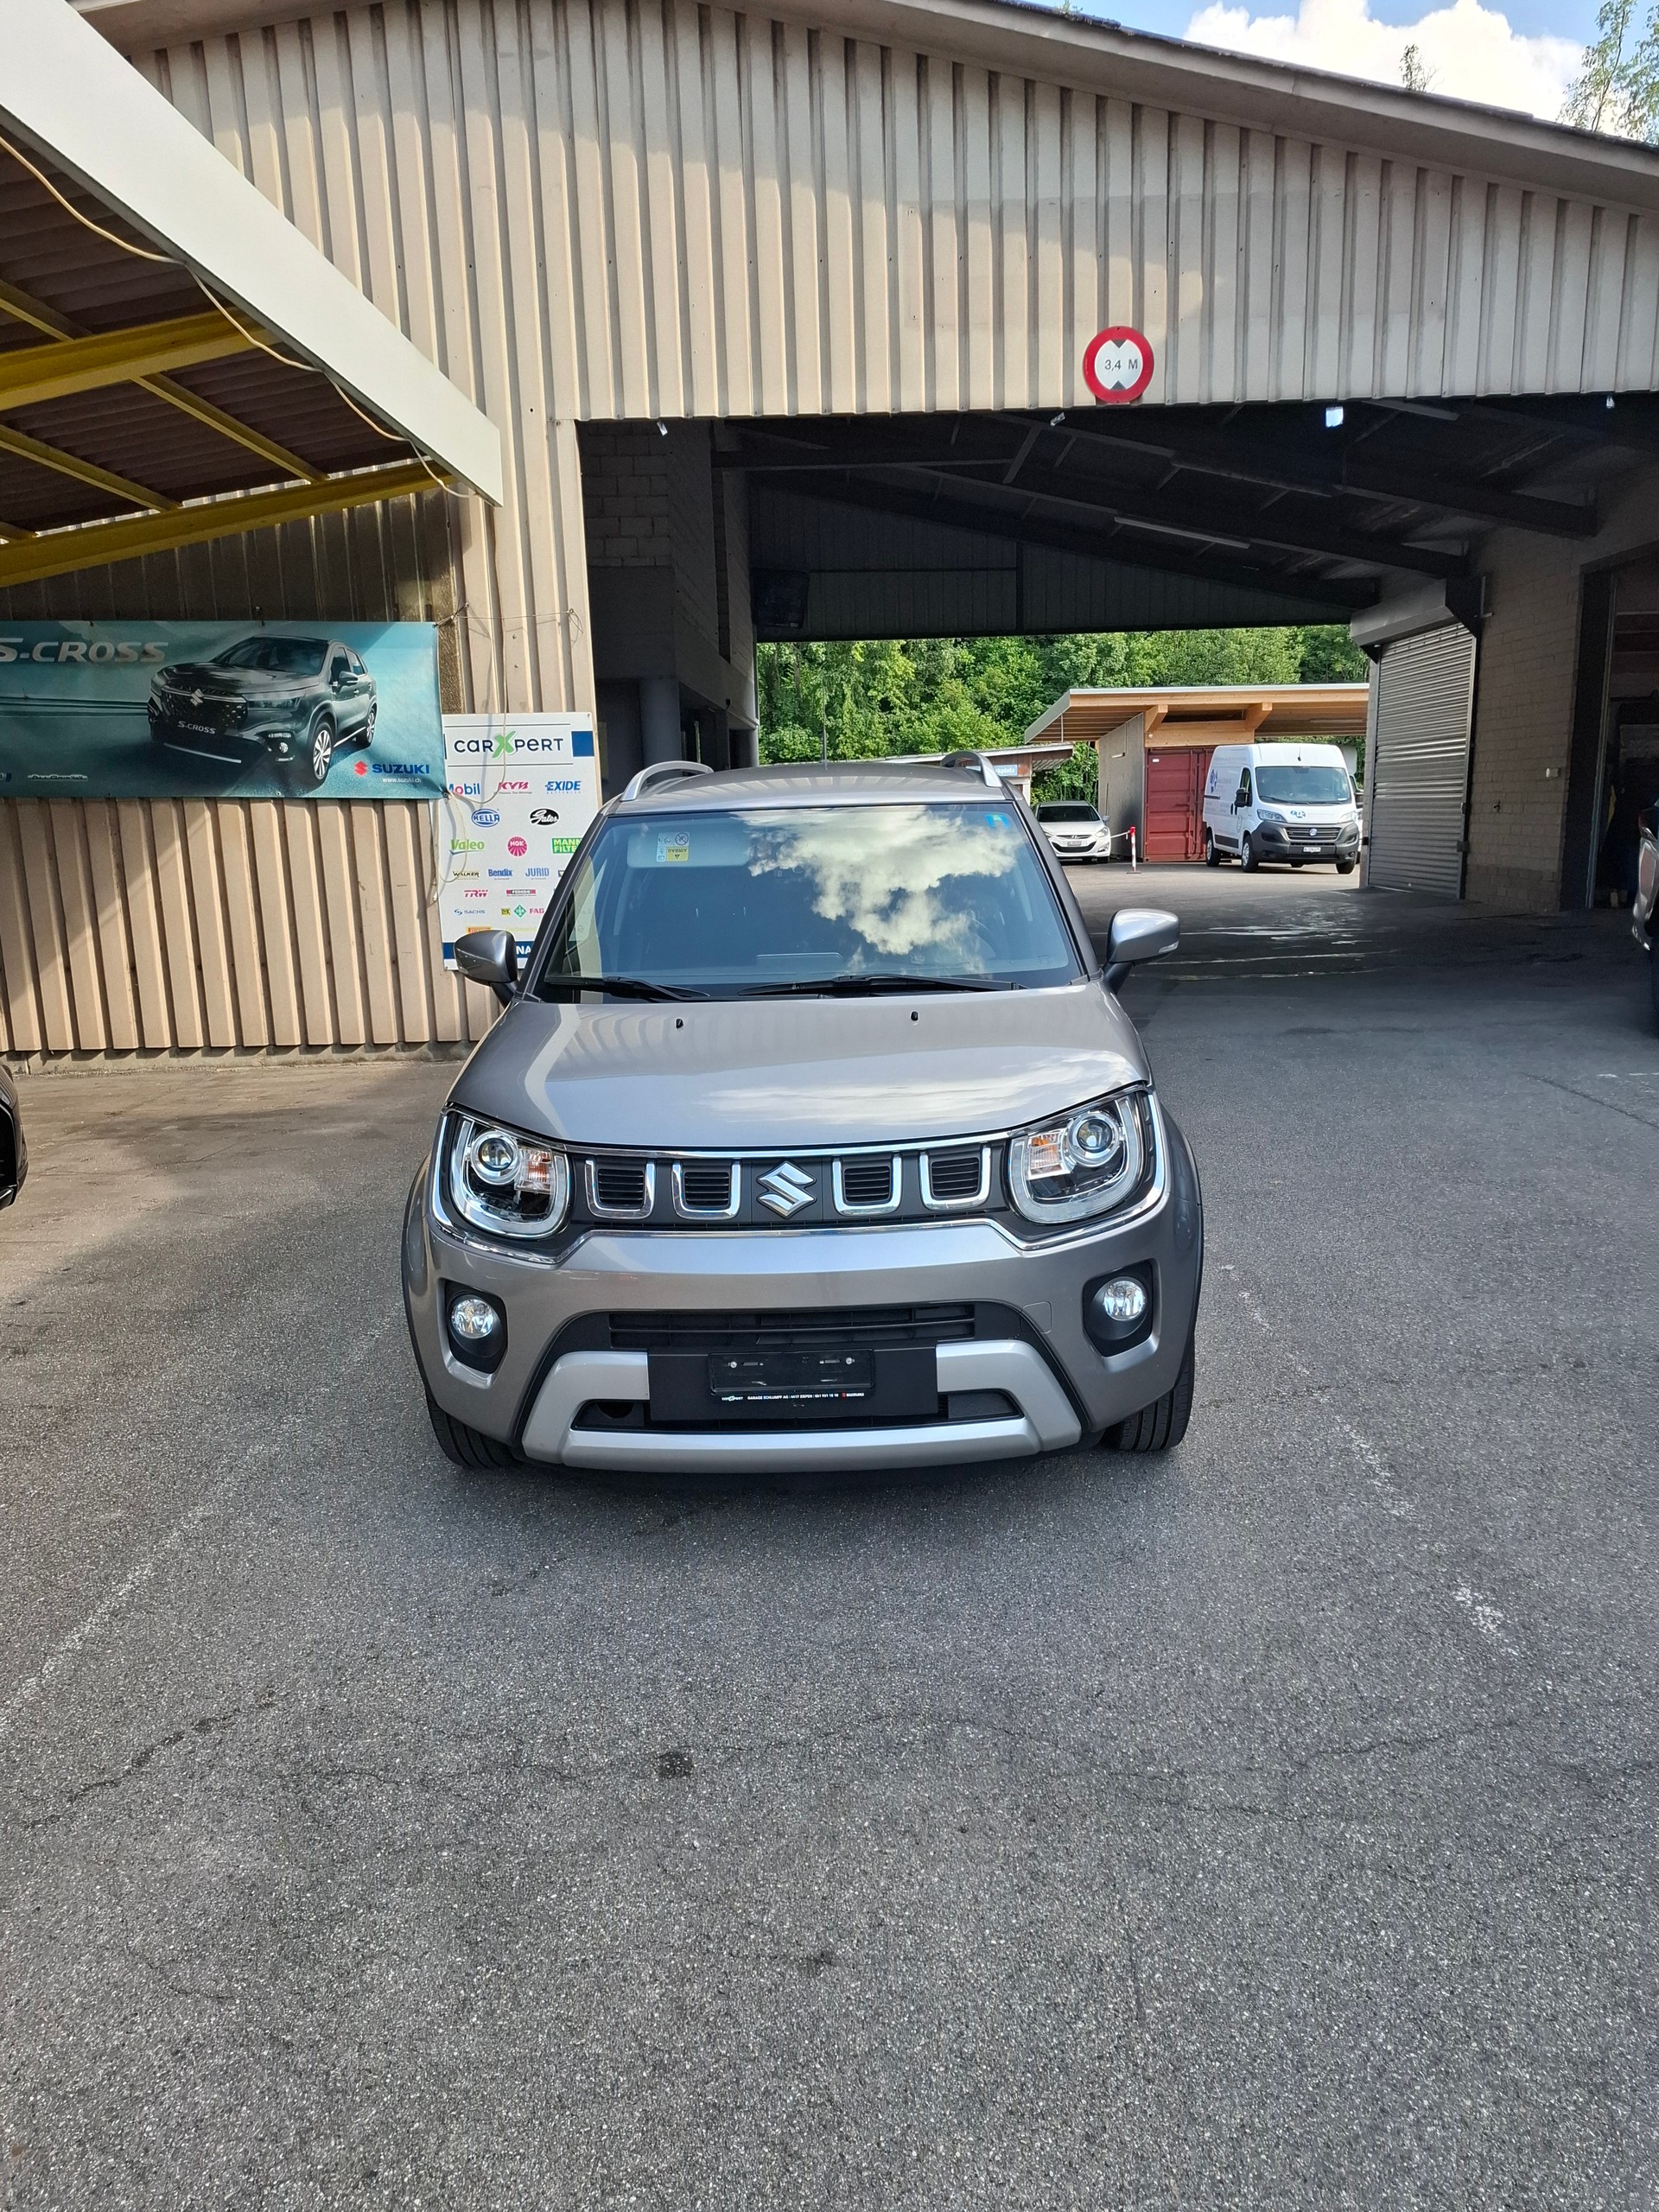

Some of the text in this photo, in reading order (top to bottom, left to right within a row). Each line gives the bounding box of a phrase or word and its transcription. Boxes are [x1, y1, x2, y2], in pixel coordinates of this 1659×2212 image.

[1104, 359, 1138, 372] 3,4 M
[177, 721, 216, 734] S-CROSS
[372, 763, 430, 774] SUZUKI
[545, 780, 582, 791] EXIDE
[473, 814, 500, 823] HELLA
[451, 839, 485, 850] Valeo
[488, 868, 512, 877] Bendix
[525, 868, 550, 876] JURID
[464, 889, 488, 898] TRW
